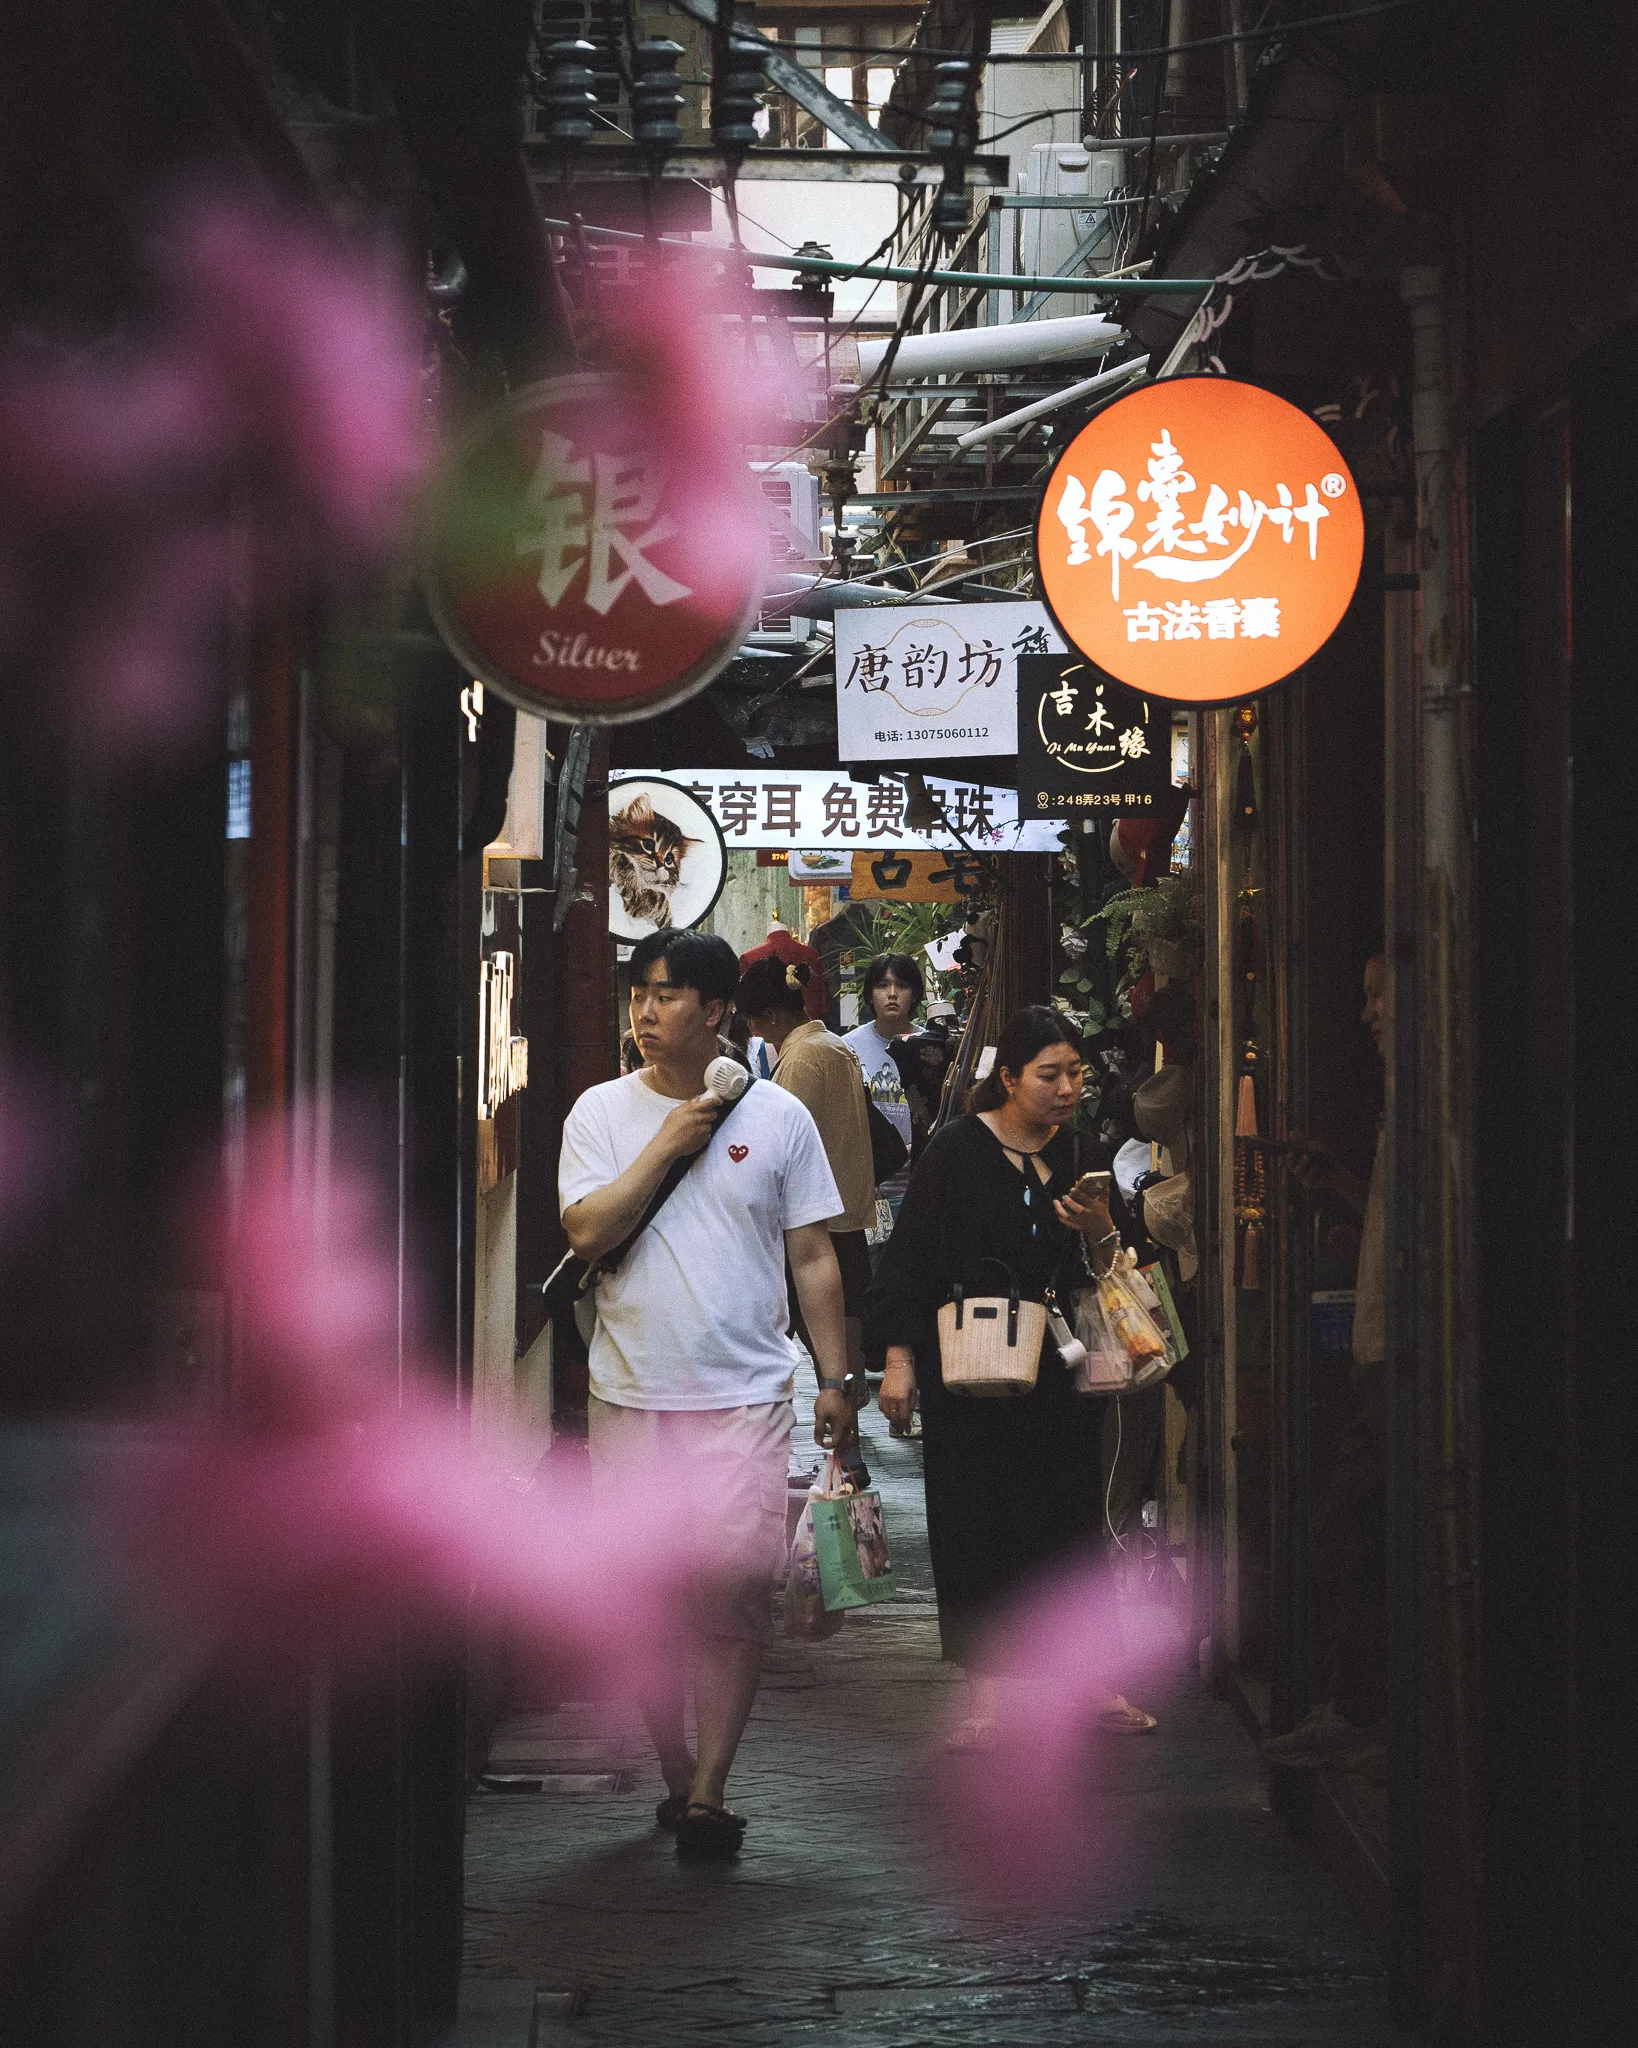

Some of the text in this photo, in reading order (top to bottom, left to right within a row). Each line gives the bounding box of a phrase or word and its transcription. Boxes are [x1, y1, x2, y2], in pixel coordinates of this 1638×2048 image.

[513, 429, 692, 616] 银
[1123, 597, 1281, 643] 古法香囊
[533, 629, 640, 672] Silver
[845, 639, 1005, 694] 唐韵坊
[907, 727, 989, 741] 13075060112
